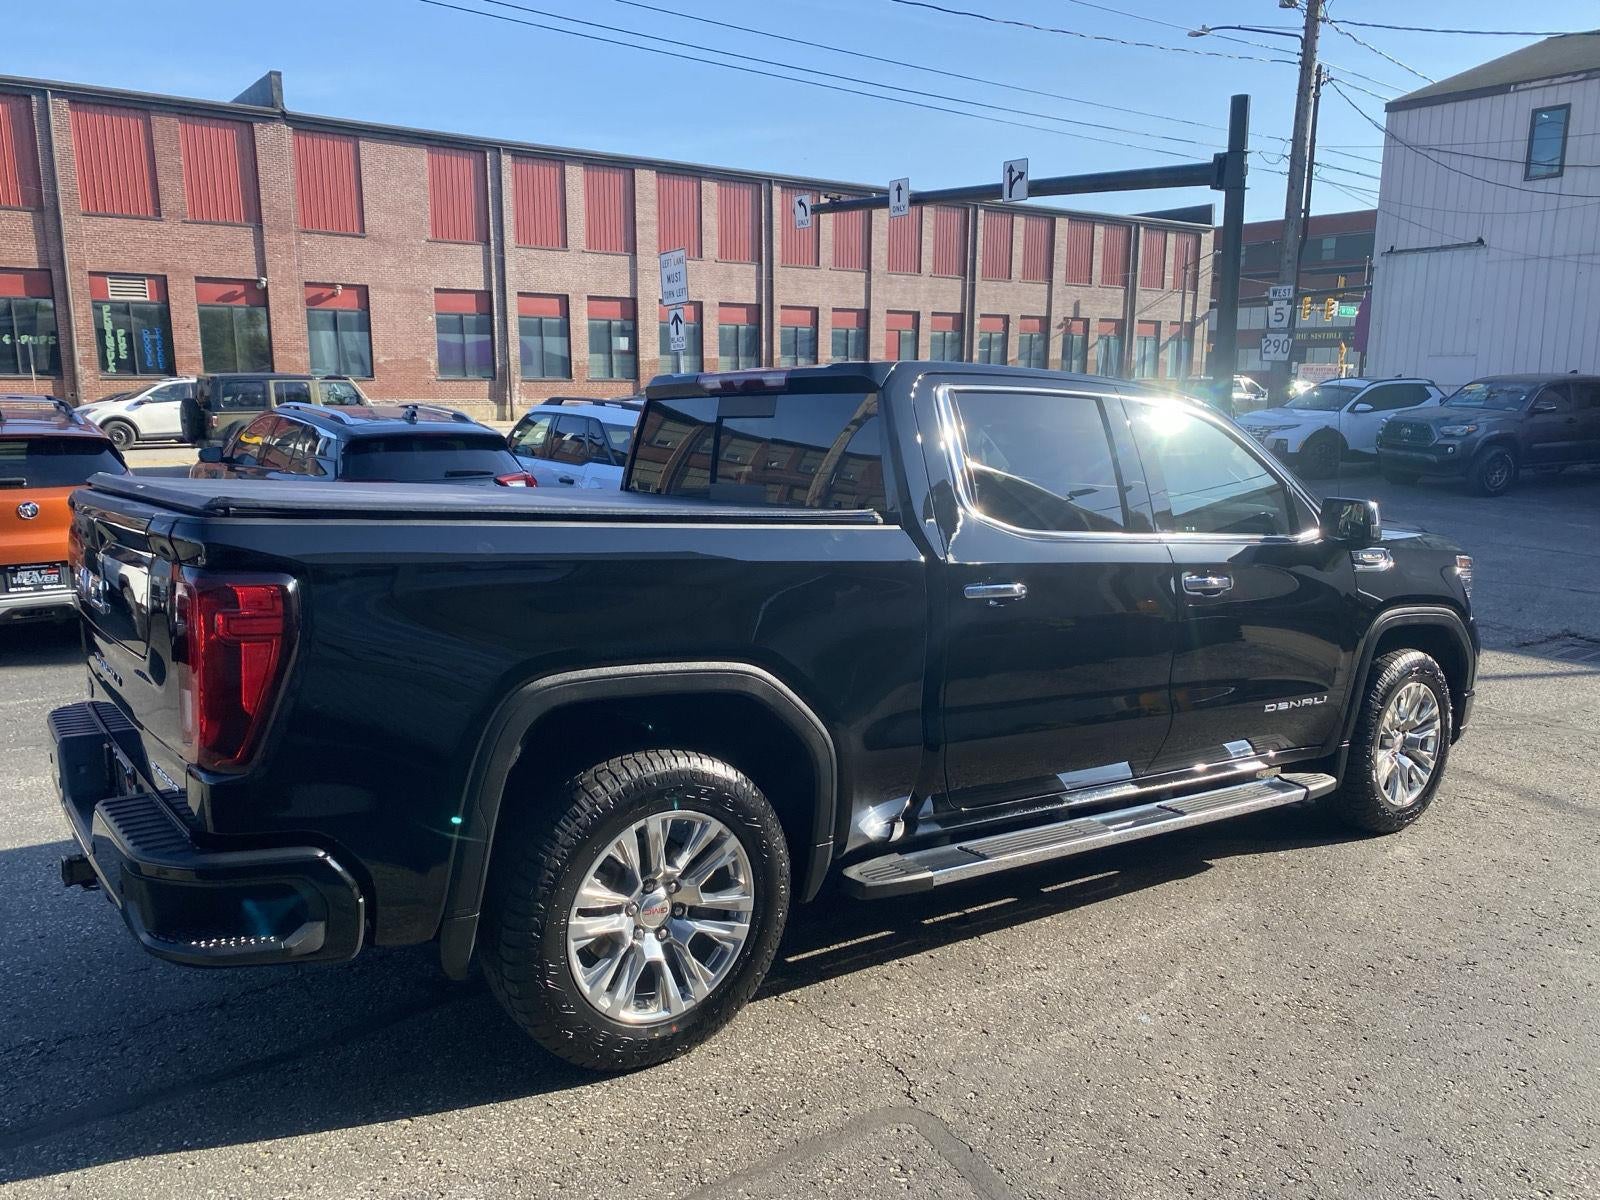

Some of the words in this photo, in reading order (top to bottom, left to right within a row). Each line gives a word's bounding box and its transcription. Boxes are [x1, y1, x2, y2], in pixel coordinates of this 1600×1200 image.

[892, 204, 906, 213] ONLY
[662, 258, 672, 269] LEFT
[673, 255, 685, 266] LANE
[666, 271, 681, 283] MUST
[663, 291, 675, 300] TURN
[675, 288, 687, 298] LEFT
[1271, 288, 1291, 298] WEST
[1274, 307, 1285, 323] 5
[20, 334, 57, 345] PUPS
[1263, 339, 1290, 354] 290
[12, 574, 60, 586] WEAVER
[1263, 695, 1328, 713] DENALI
[643, 906, 669, 916] GMC
